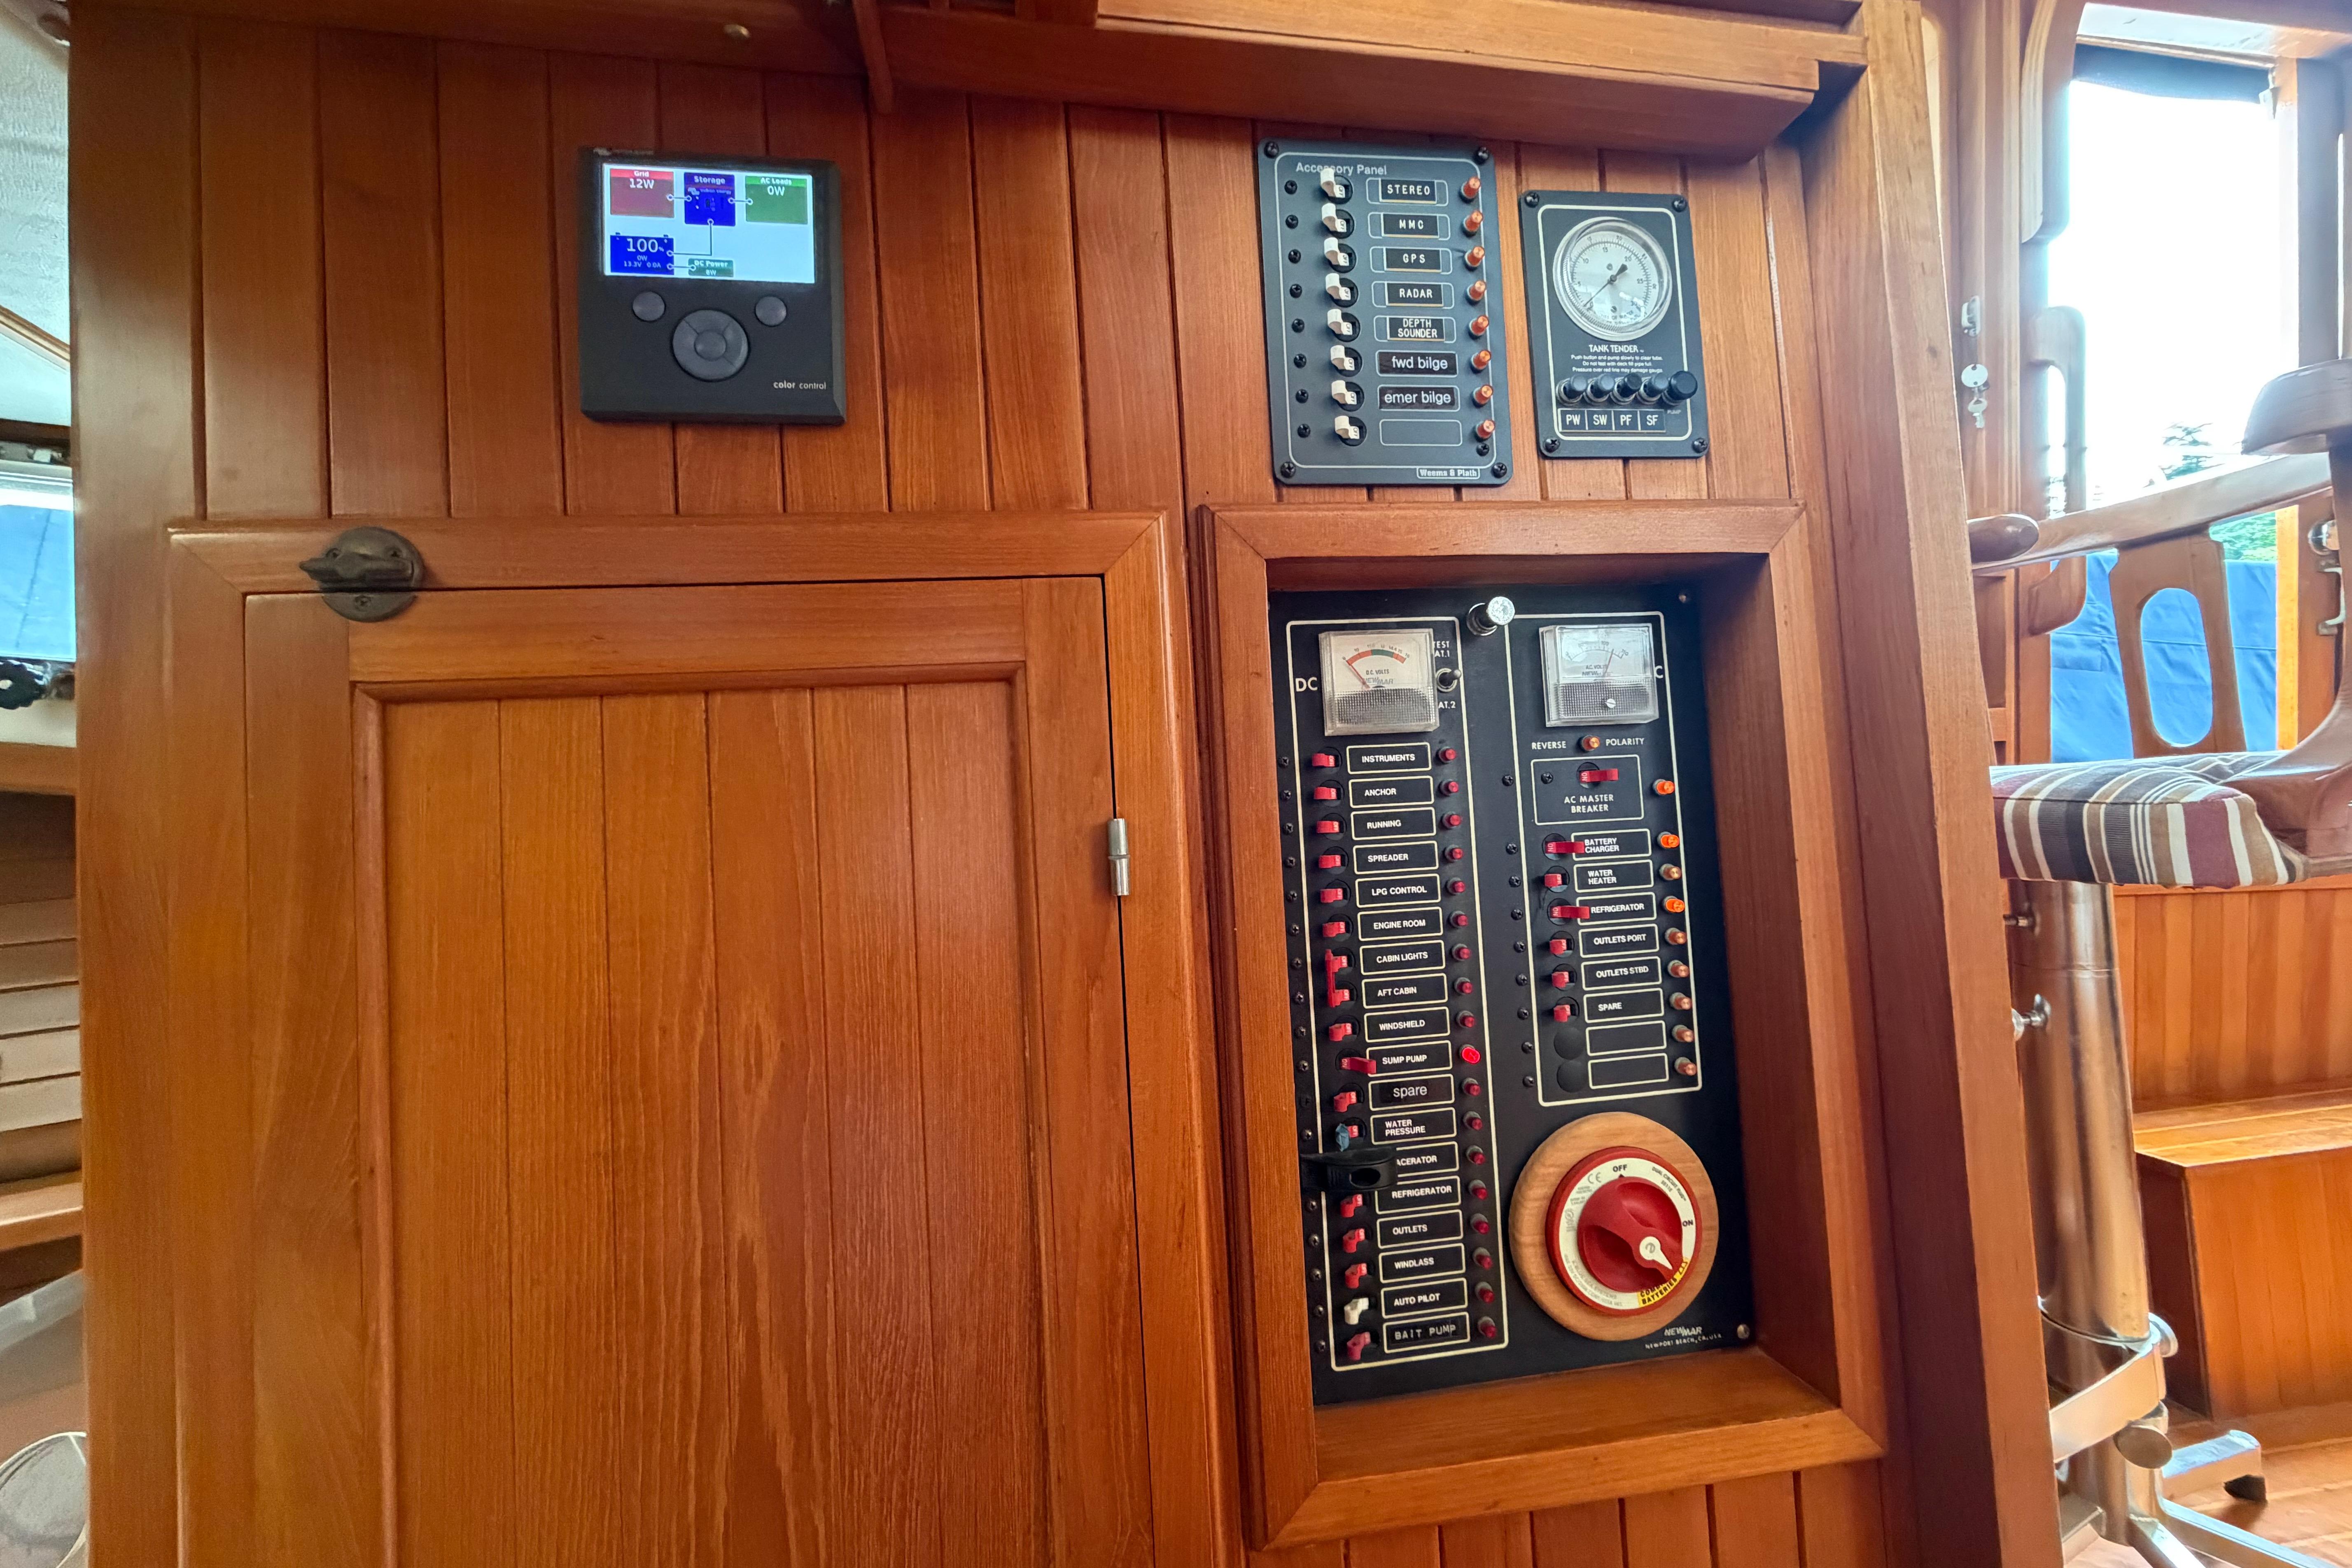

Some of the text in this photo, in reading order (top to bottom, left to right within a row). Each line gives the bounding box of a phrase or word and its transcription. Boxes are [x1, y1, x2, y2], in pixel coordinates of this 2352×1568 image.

[1357, 164, 1387, 175] Panel
[630, 178, 654, 189] 12W
[694, 176, 726, 185] Storage
[767, 186, 785, 196] 0W
[1387, 184, 1430, 196] STEREO
[1399, 220, 1424, 230] MMC
[1403, 254, 1426, 264] GPS
[1400, 289, 1433, 299] RADAR
[1403, 318, 1432, 328] DEPTH
[1398, 328, 1438, 338] SOUNDER
[1610, 345, 1638, 353] TENDER
[1392, 356, 1448, 371] fwd bilge
[773, 380, 796, 389] color
[1384, 391, 1451, 406] emer bilge
[1566, 414, 1580, 425] PW
[1593, 414, 1607, 425] SW
[1620, 415, 1632, 426] PF
[1647, 415, 1659, 426] SF
[1296, 677, 1318, 692] DC
[1531, 738, 1645, 750] REVERSE POLARITY
[1362, 754, 1415, 763] INSTRUMENTS
[1580, 794, 1614, 803] MASTER
[1571, 804, 1609, 814] BREAKER
[1367, 820, 1402, 829] RUNNING
[1584, 838, 1617, 846] BATTERY
[1585, 845, 1619, 854] CHARGER
[1367, 853, 1409, 862] SPREADER
[1588, 876, 1617, 885] HEATER
[1372, 886, 1428, 896] LPG CONTROL
[1591, 903, 1645, 914] REFRIGERATOR
[1373, 919, 1426, 930] ENGINE ROOM
[1594, 933, 1647, 945] OUTLETS PORT
[1377, 952, 1428, 964] CABIN LIGHTS
[1596, 968, 1628, 978] OUTLETS
[1377, 987, 1417, 997] AFT CABIN
[1598, 1002, 1622, 1011] SPARE
[1379, 1020, 1426, 1030] WINDSHIELD
[1382, 1055, 1427, 1065] SUMP PUMP
[1393, 1085, 1428, 1099] spare
[1385, 1119, 1412, 1129] WATER
[1385, 1126, 1426, 1136] PRESSURE
[1396, 1155, 1437, 1167] ACERATOR
[1613, 1164, 1627, 1173] OFF
[1392, 1186, 1452, 1199] REFRIGERATOR
[1393, 1225, 1428, 1235] OUTLETS
[1394, 1257, 1434, 1269] WINDLASS
[1642, 1278, 1677, 1304] BATTERIES
[1394, 1293, 1441, 1307] AUTO PILOT
[1395, 1324, 1456, 1340] BAIT PUMP
[1664, 1326, 1702, 1336] NEWMAR
